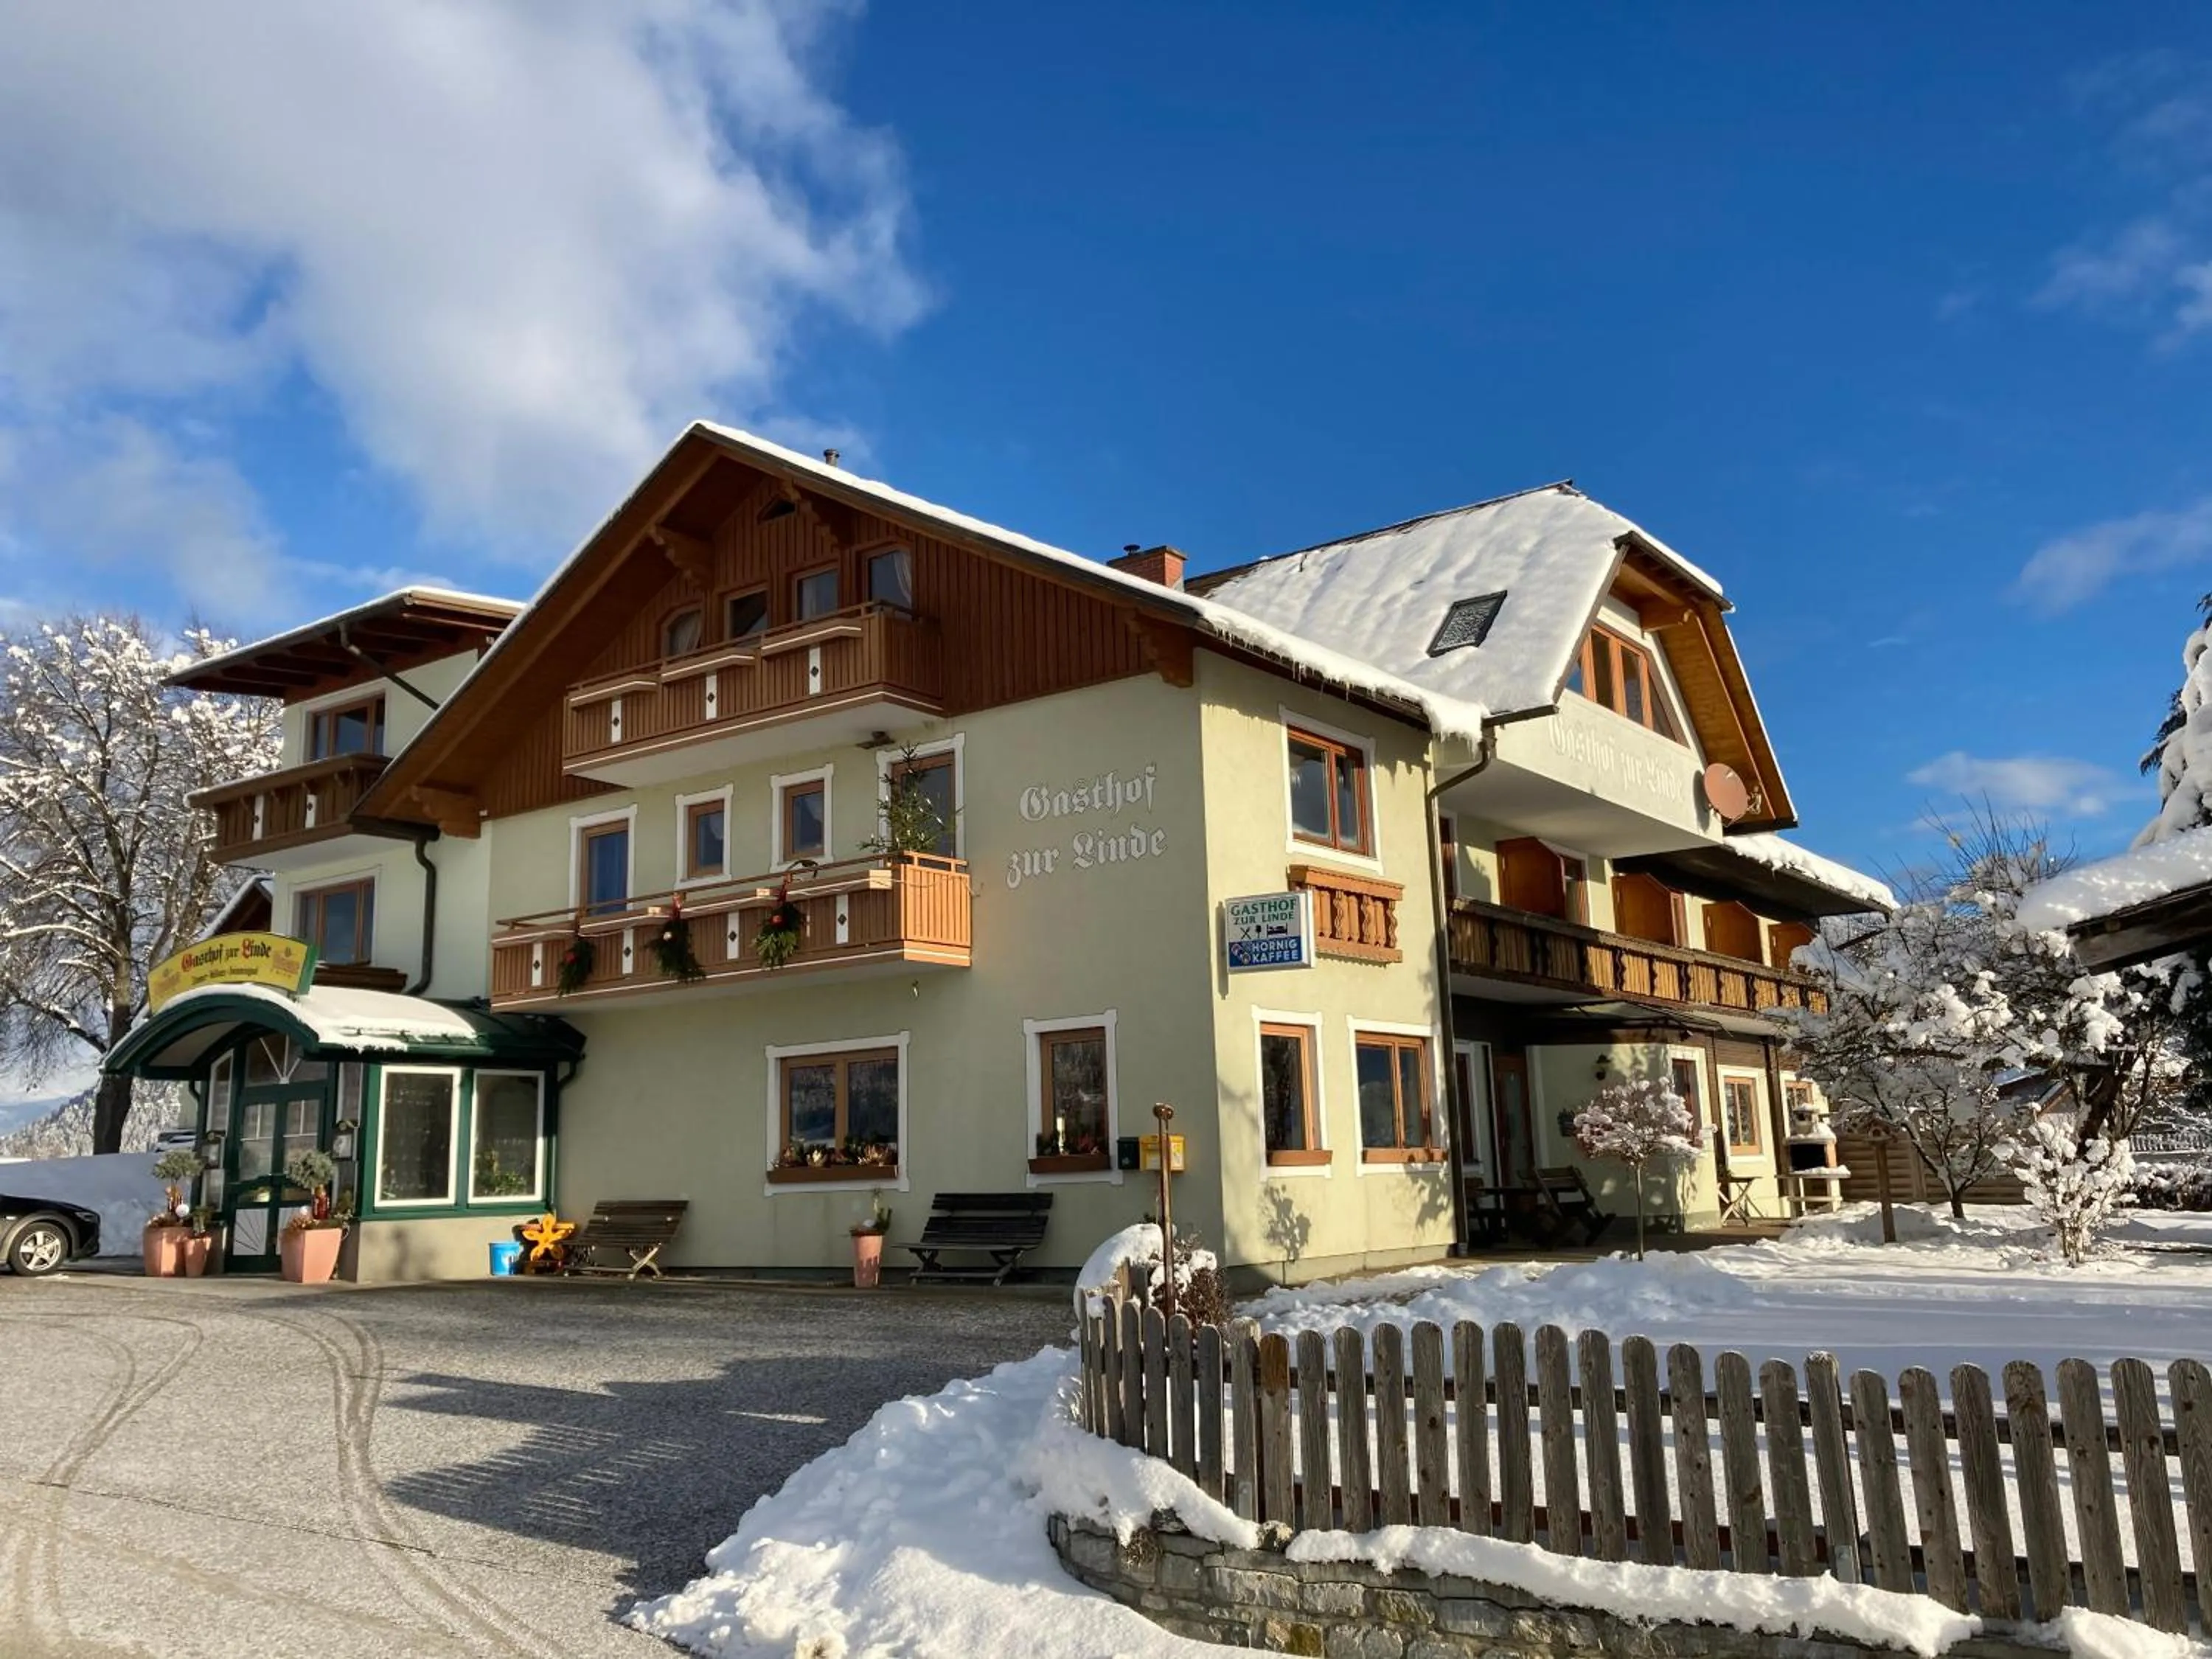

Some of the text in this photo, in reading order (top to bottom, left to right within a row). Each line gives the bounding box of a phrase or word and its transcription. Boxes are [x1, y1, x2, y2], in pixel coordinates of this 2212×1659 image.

[1548, 715, 1683, 801] Gasthof zur Linde
[1019, 762, 1157, 821] Gasthof
[1006, 824, 1167, 888] zur Linde
[1231, 899, 1296, 916] GASTHOF
[1234, 911, 1294, 925] ZUR LINDE
[181, 938, 271, 972] Gasthof zur Linde
[1252, 939, 1297, 952] HORNIG
[1253, 950, 1298, 962] KAFFEE
